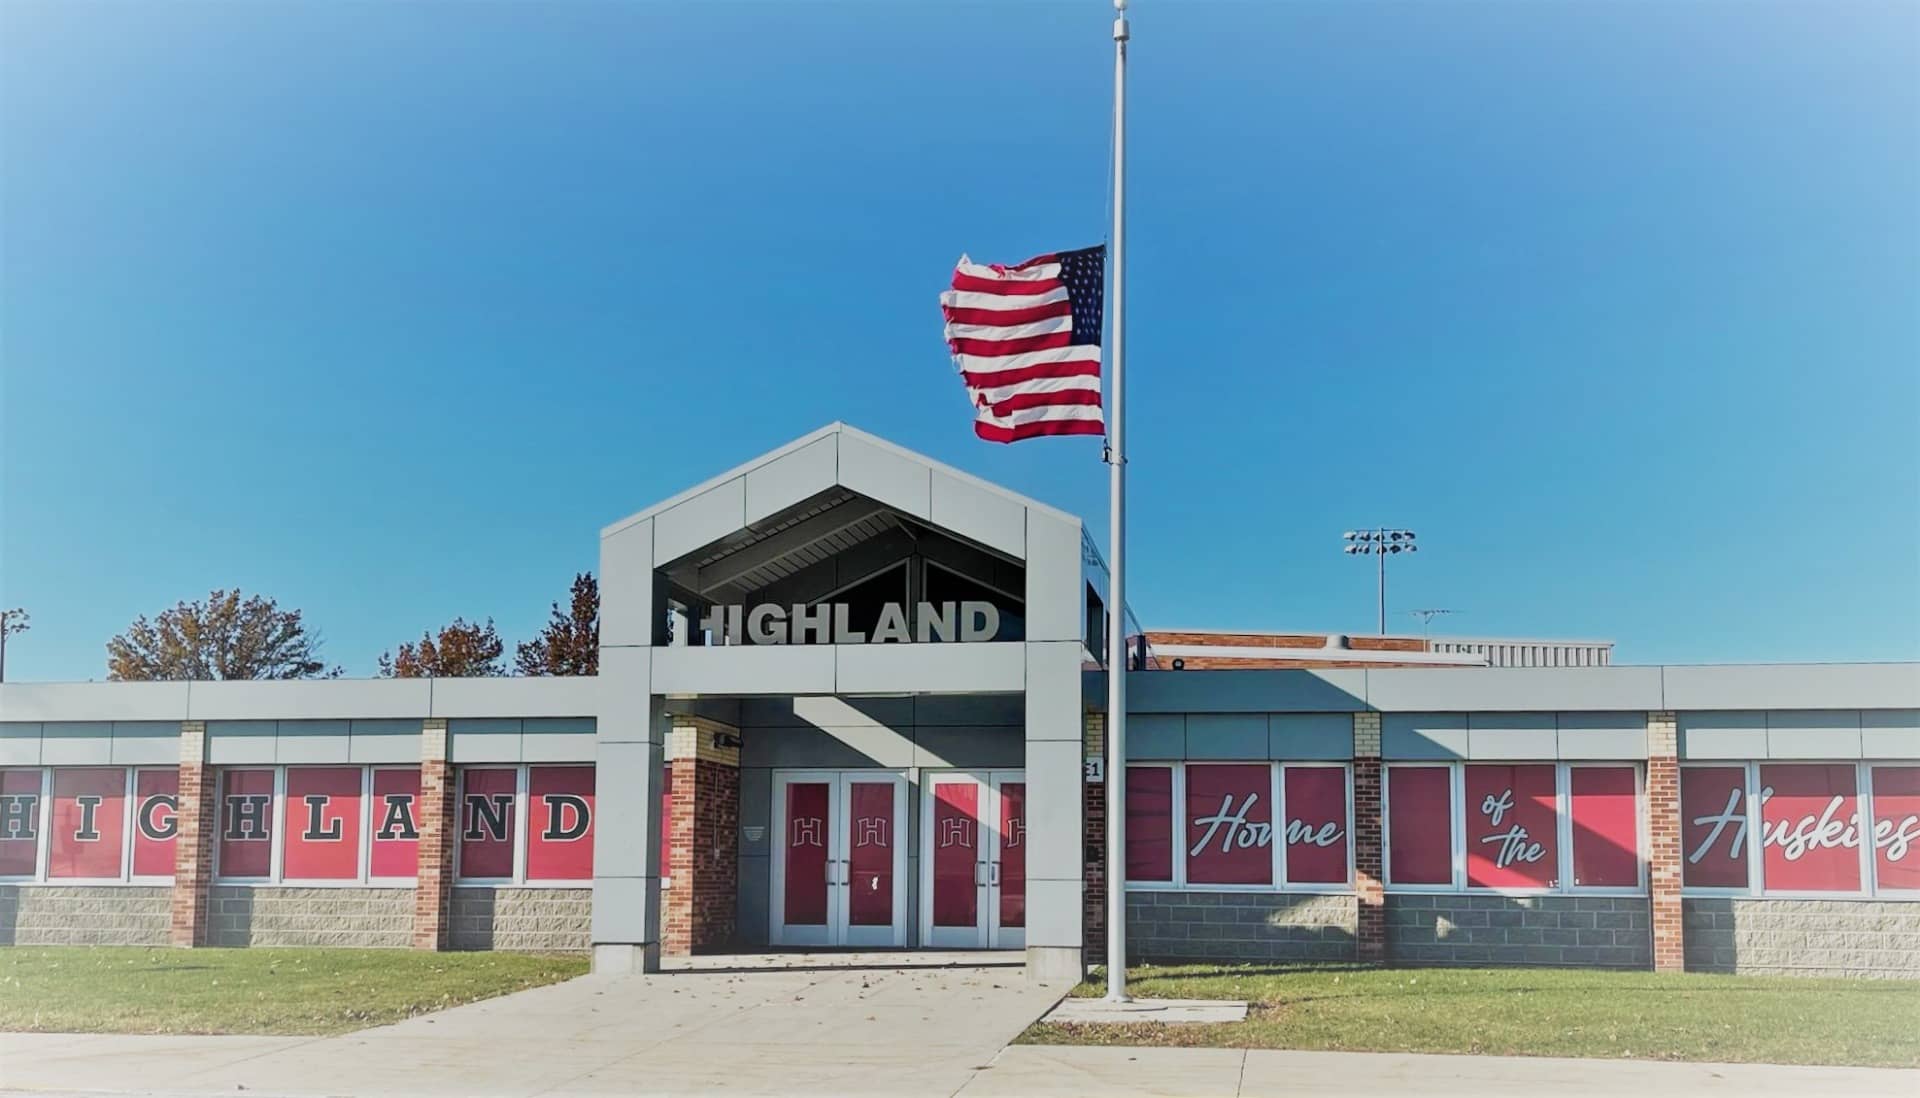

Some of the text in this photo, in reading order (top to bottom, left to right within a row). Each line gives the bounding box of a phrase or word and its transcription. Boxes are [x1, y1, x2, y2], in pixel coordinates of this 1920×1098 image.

[700, 601, 1000, 645] HIGHLAND
[1190, 793, 1345, 857] Home
[1482, 789, 1514, 826] of
[1689, 787, 1920, 864] Huskies
